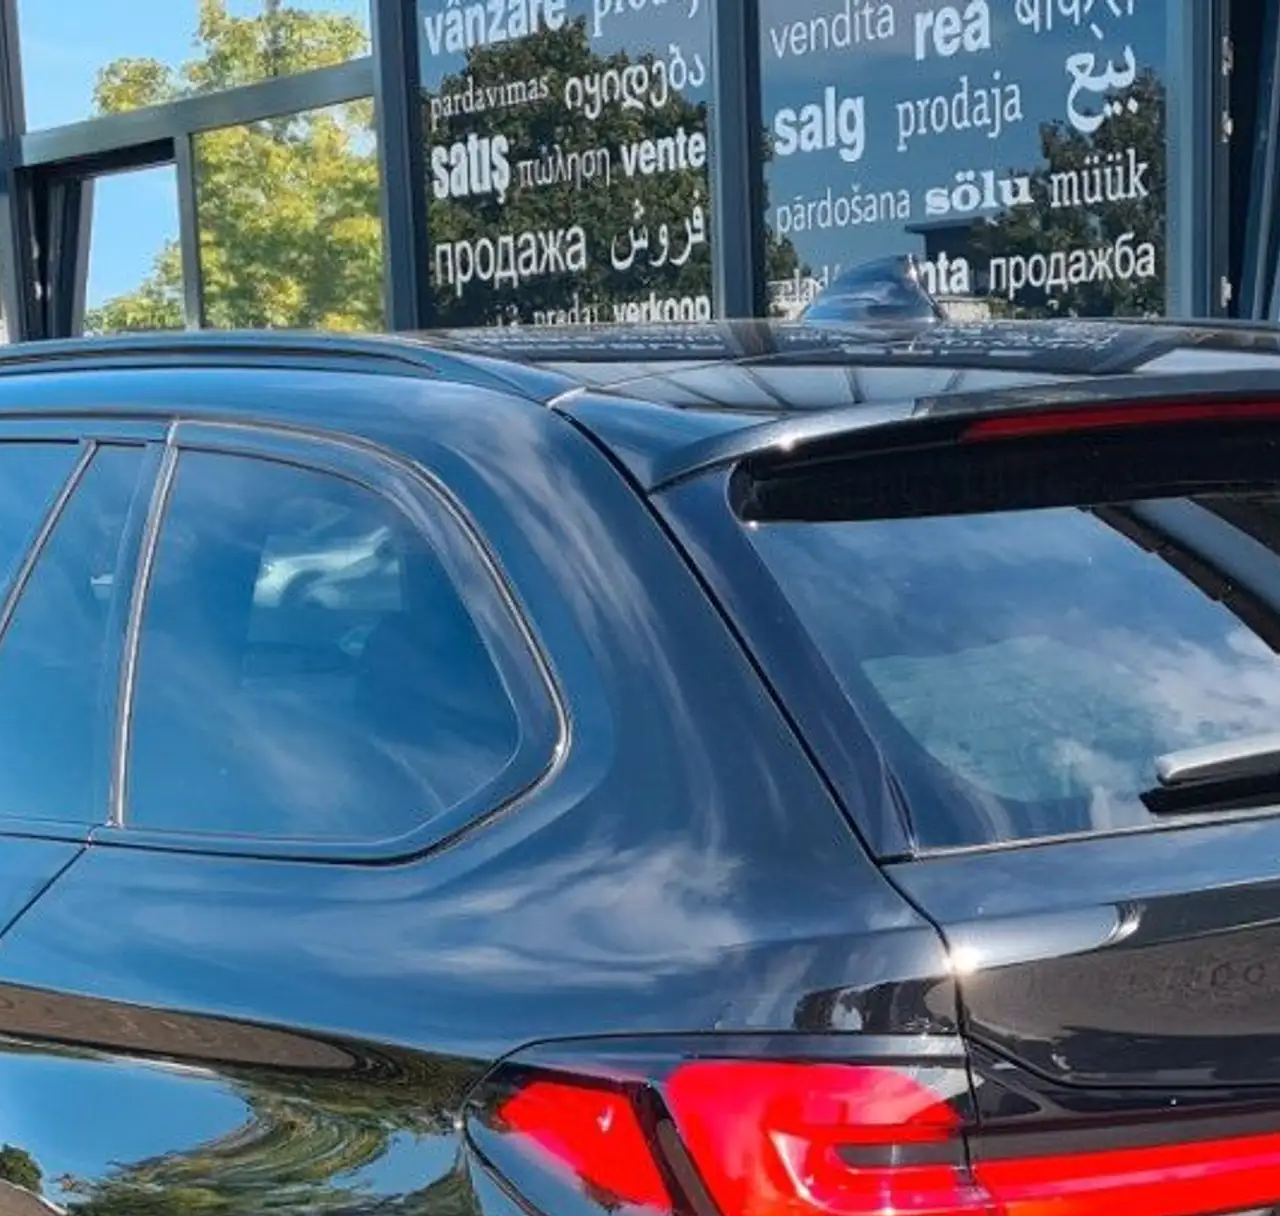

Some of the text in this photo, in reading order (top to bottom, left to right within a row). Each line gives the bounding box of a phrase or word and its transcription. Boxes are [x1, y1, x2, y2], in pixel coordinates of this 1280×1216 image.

[770, 0, 895, 58] vendita
[915, 0, 992, 60] rea
[430, 72, 549, 132] pardavimas
[565, 44, 706, 119] იყიდება
[895, 70, 1023, 152] prodaja
[621, 127, 707, 176] vente
[773, 86, 865, 162] salg
[431, 131, 511, 204] satış
[516, 144, 611, 190] πώληση
[925, 169, 1035, 215] sölu
[1051, 148, 1150, 208] müük
[435, 225, 587, 297] продажа
[610, 189, 707, 270] فروش
[990, 233, 1156, 299] продажба
